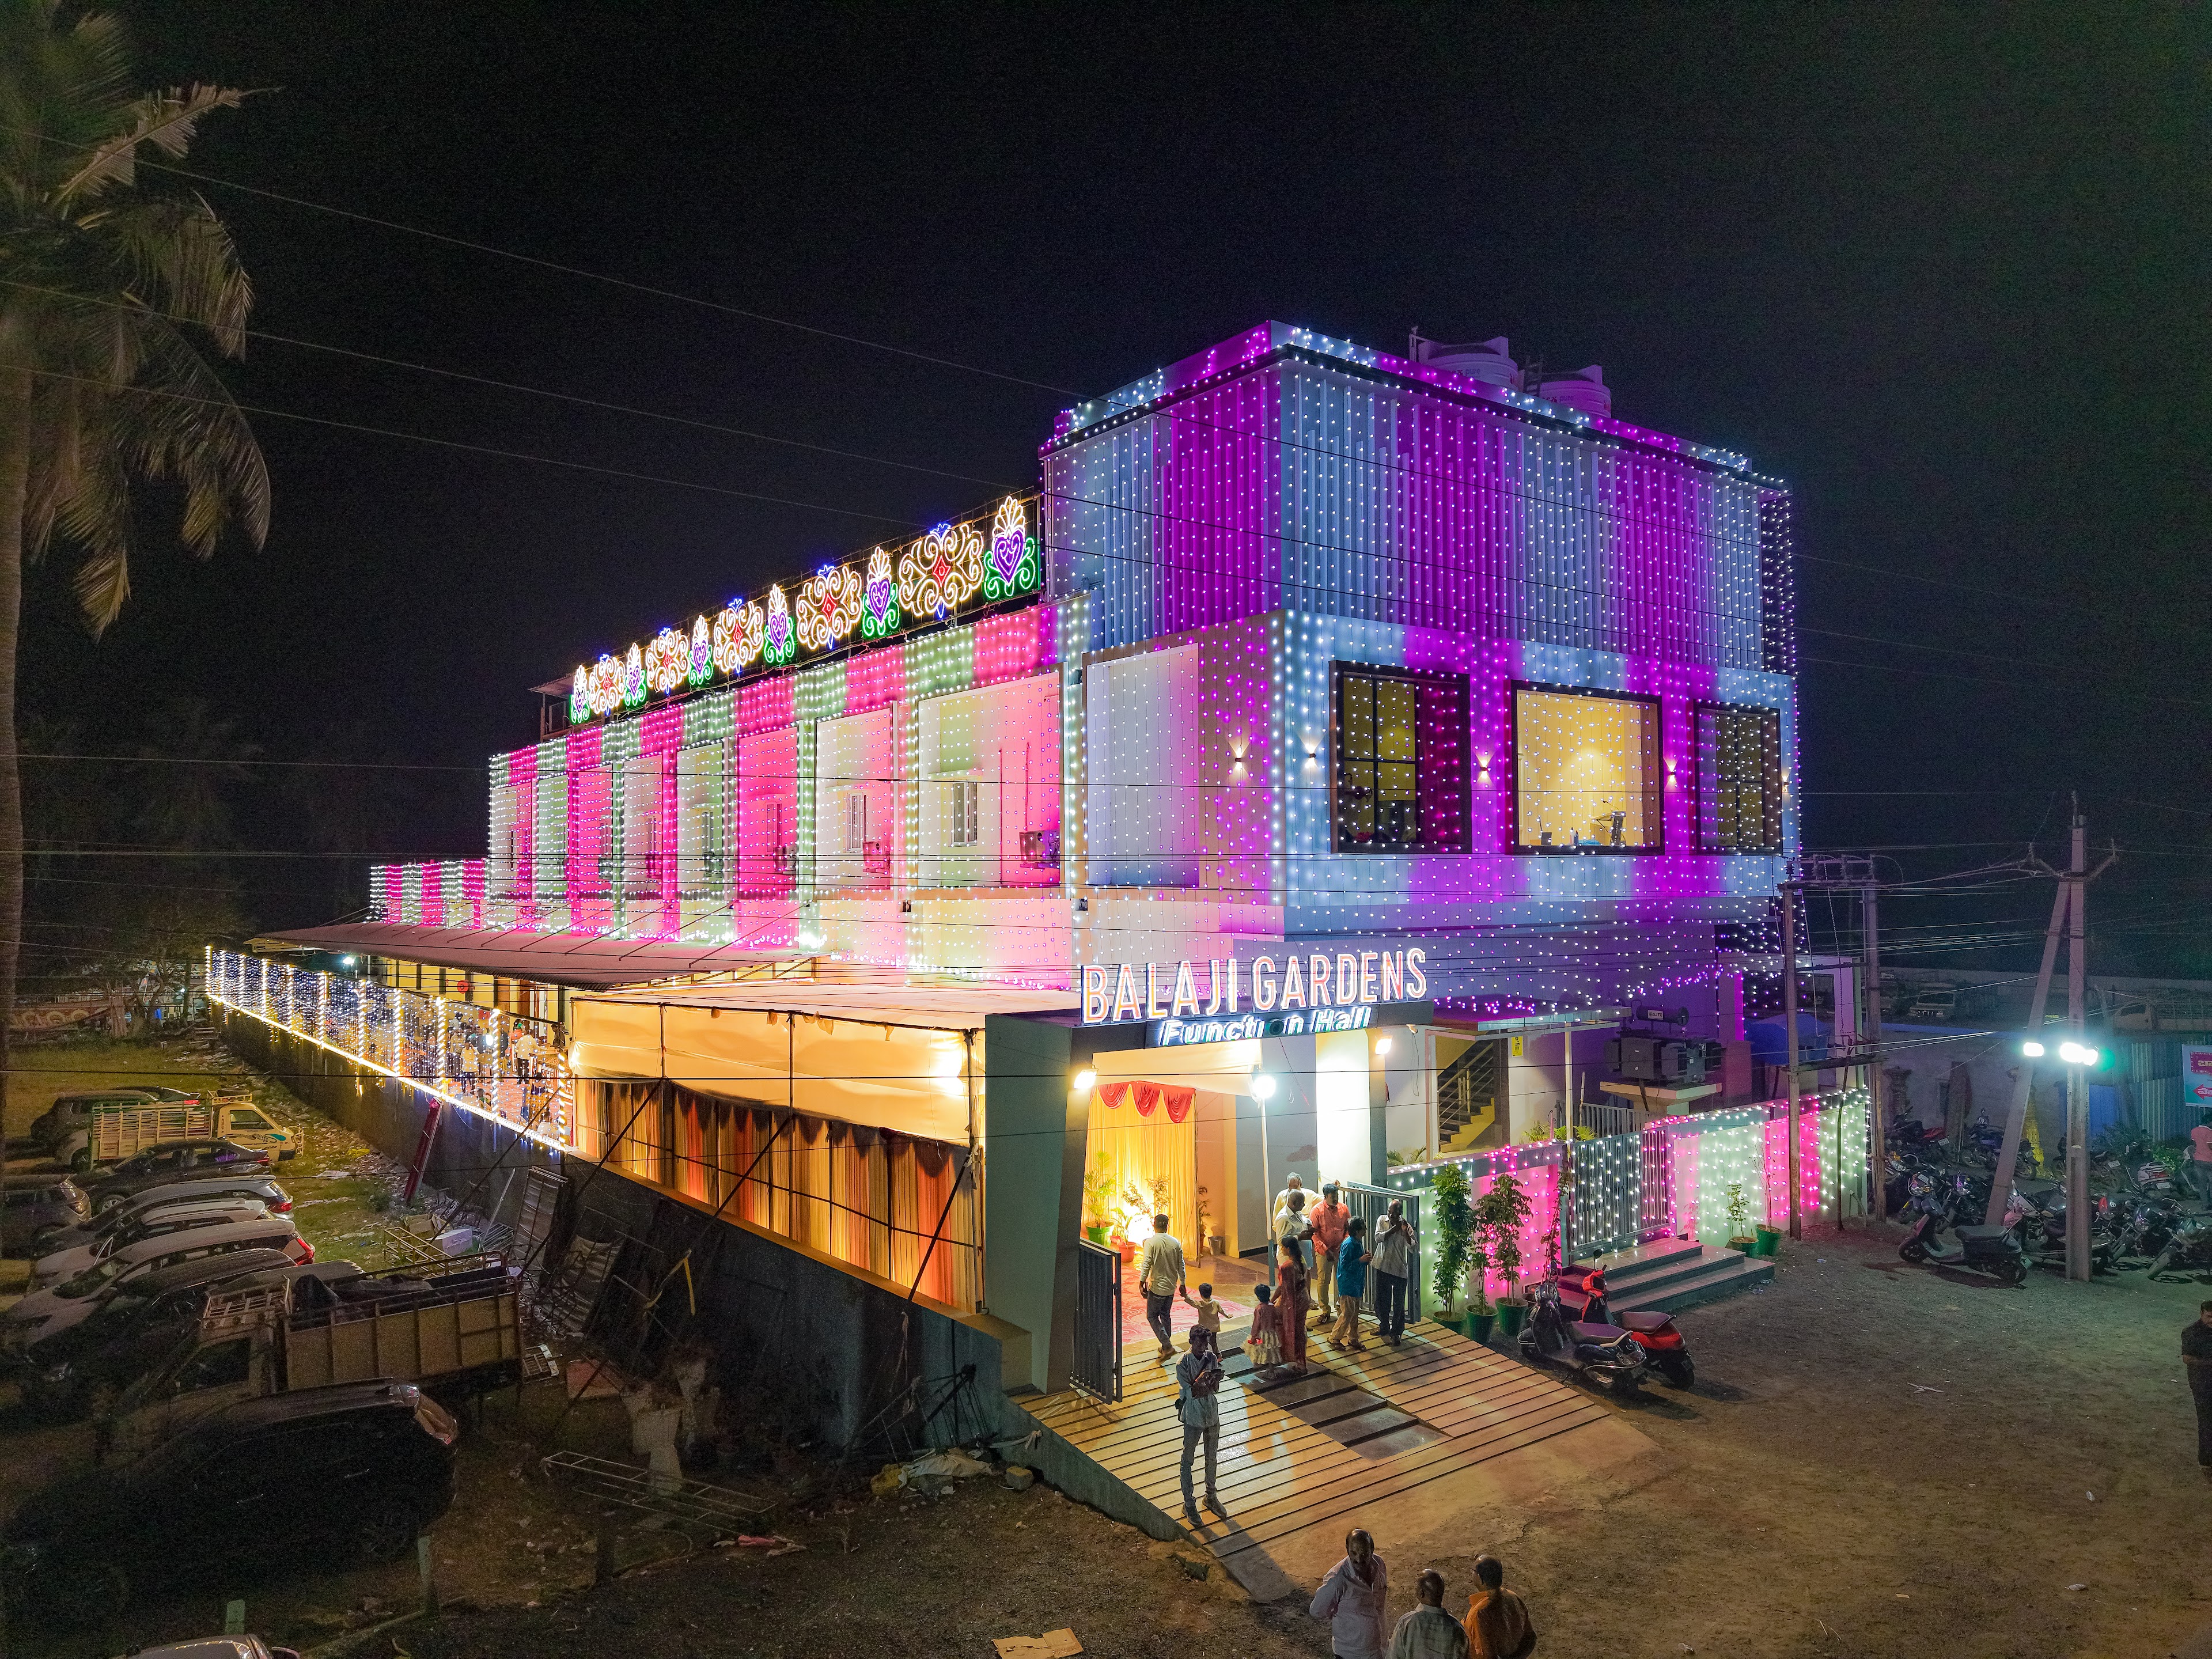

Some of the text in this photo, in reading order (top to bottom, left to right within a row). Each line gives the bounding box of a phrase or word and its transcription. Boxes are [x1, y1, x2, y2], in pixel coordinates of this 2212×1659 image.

[1081, 948, 1427, 1024] BALAJI GARDENS
[1158, 1006, 1372, 1046] Function Hall
